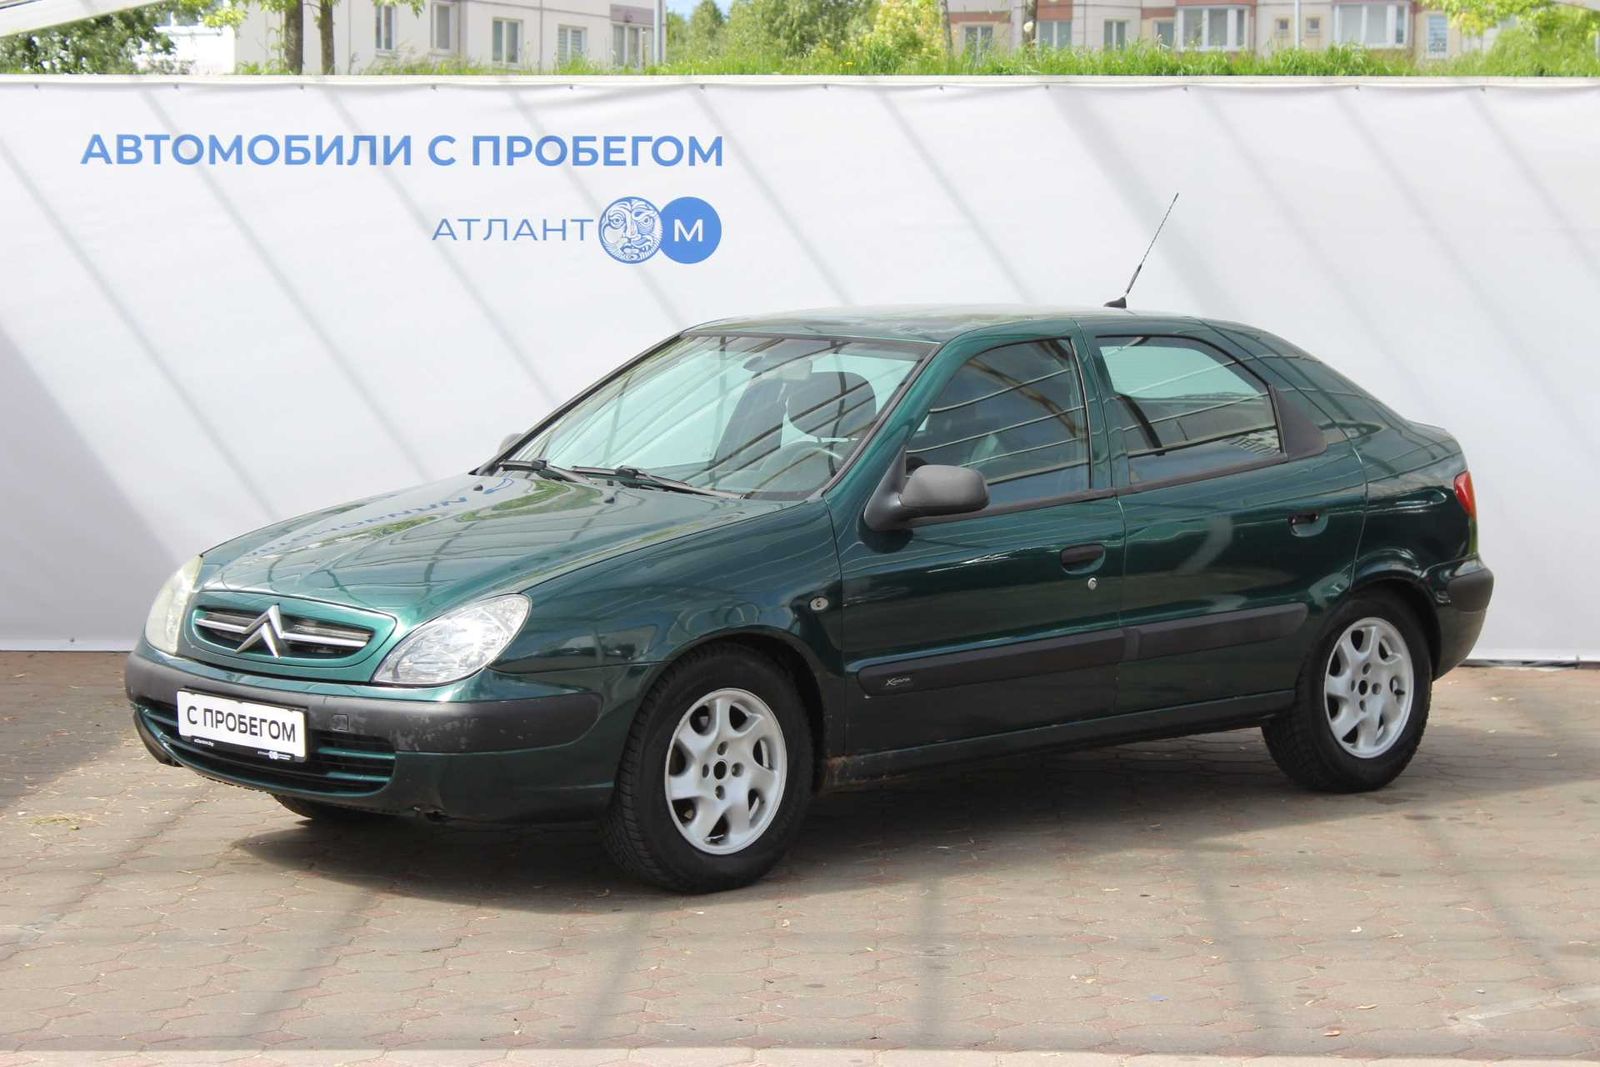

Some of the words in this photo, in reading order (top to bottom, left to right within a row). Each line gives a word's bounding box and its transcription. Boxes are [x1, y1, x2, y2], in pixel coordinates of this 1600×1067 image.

[80, 134, 412, 167] АВТОМОБИЛИ
[428, 134, 456, 167] С
[472, 134, 724, 167] ПРОБЕГОМ
[432, 218, 595, 241] АТЛАНТ
[673, 218, 704, 242] М
[186, 705, 198, 725] С
[203, 707, 296, 743] ПРОБЕГОМ
